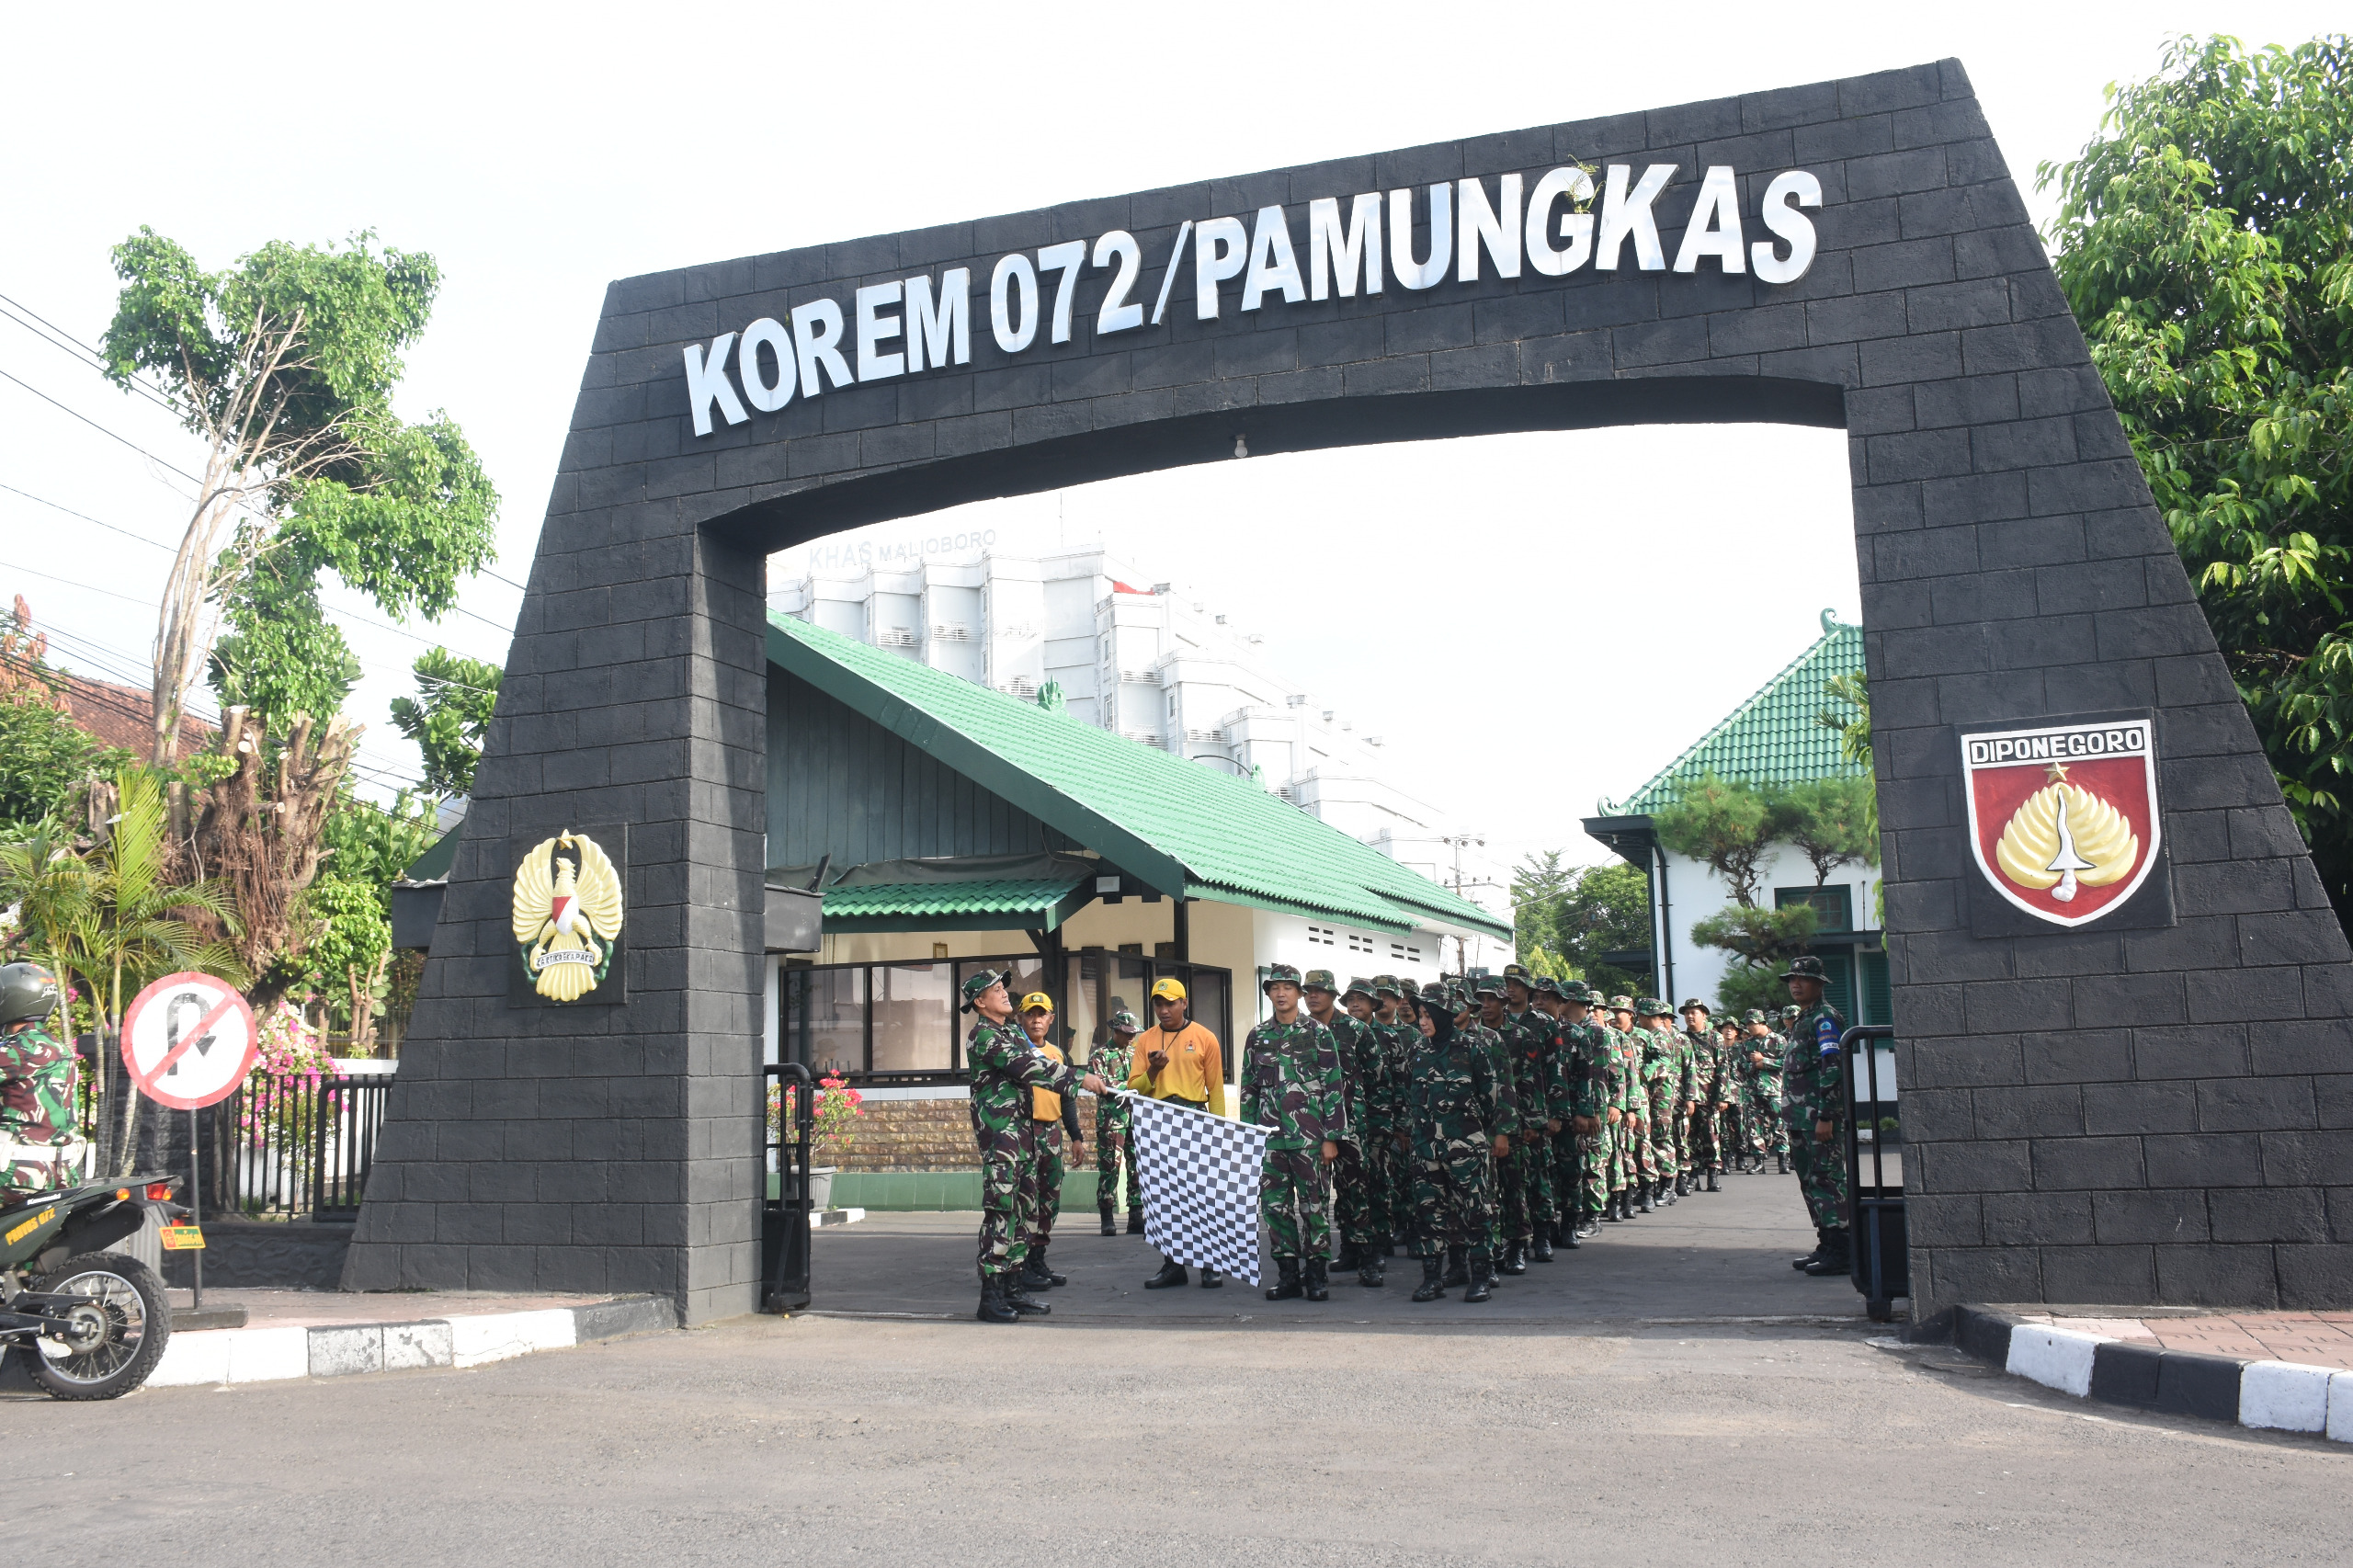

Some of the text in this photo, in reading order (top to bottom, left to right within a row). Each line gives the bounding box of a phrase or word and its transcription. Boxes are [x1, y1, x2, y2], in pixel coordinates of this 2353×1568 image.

[683, 267, 972, 437] KOREM
[810, 528, 996, 570] KHAS MALIOBORO
[1971, 729, 2144, 764] DIPONEGORO
